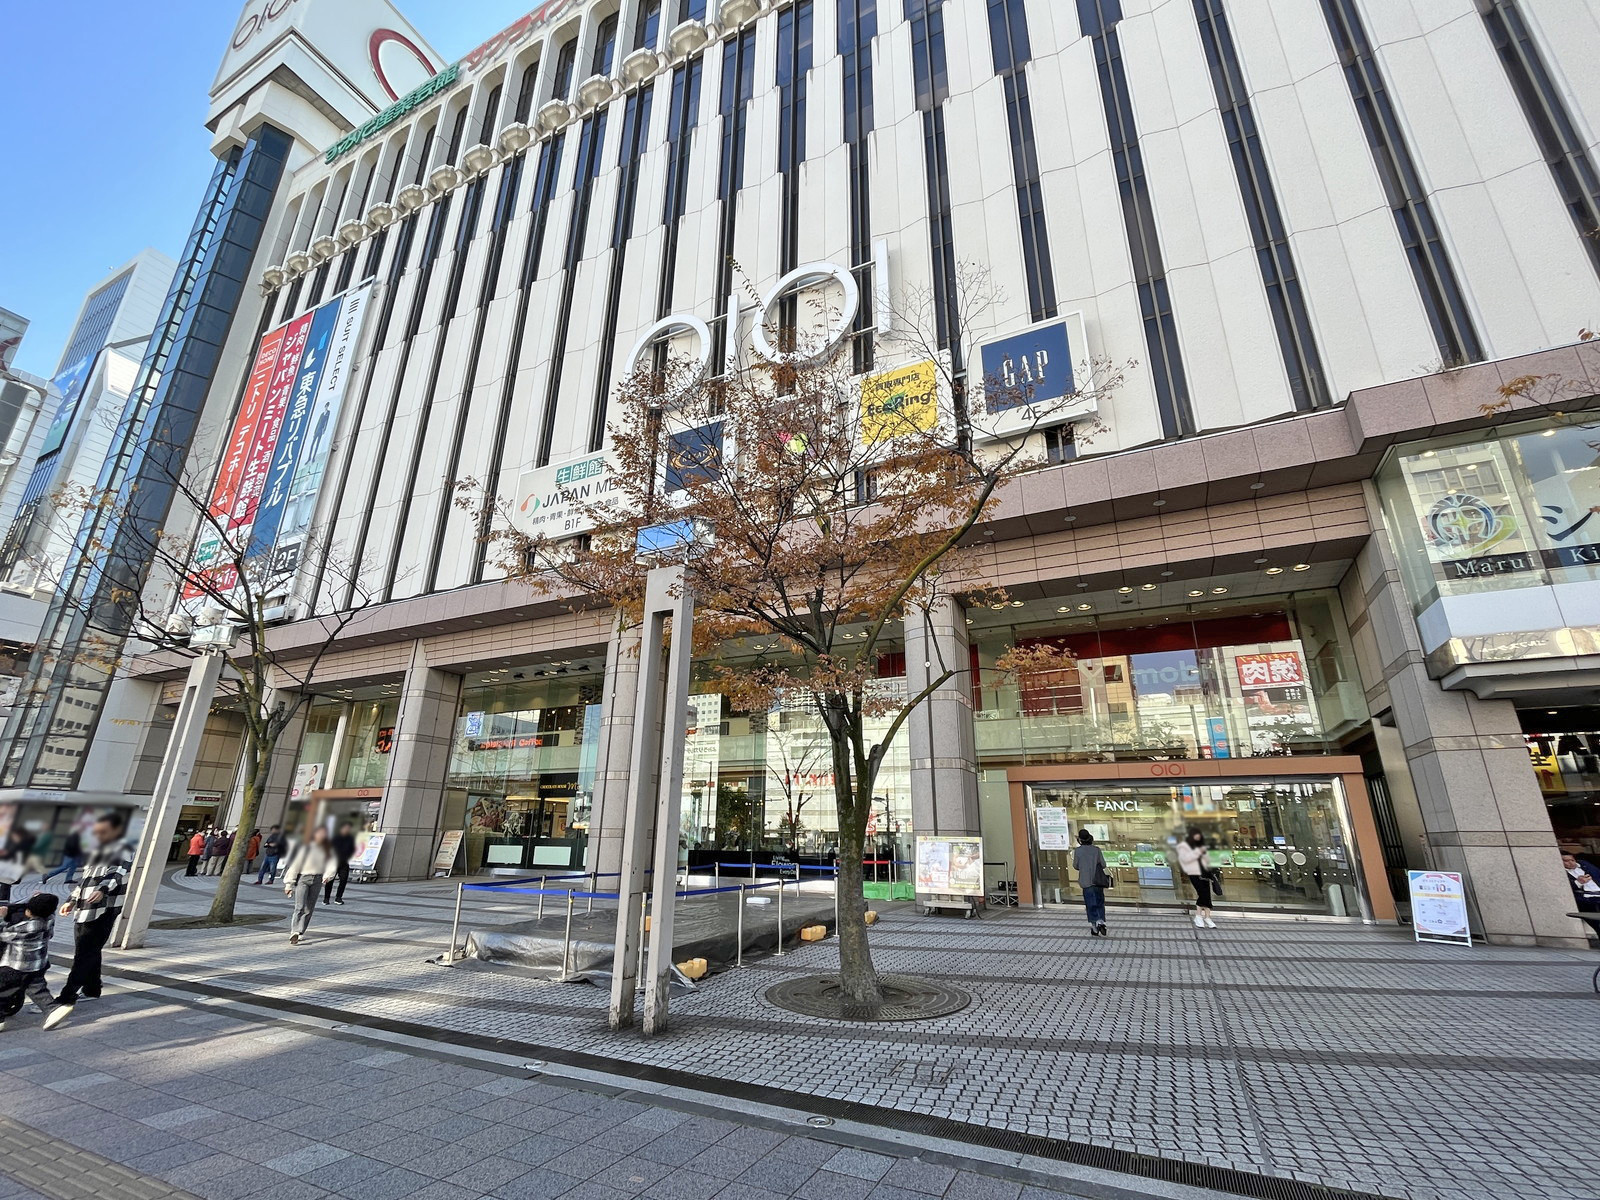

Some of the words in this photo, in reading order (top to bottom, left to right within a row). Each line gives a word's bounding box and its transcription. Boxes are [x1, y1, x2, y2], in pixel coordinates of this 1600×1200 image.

[342, 316, 355, 342] SUIT
[328, 345, 346, 391] SELECT
[1002, 350, 1049, 387] GAP
[246, 373, 266, 419] ニトリ
[235, 331, 300, 519] ジャパンミート生鮮館
[264, 371, 317, 509] 東急リバブル
[216, 423, 252, 507] デコホーム
[557, 457, 604, 483] 生鮮館
[542, 484, 590, 508] JAPAN
[595, 478, 620, 495] ME
[564, 517, 582, 531] B1F
[276, 548, 297, 570] 2F
[1455, 554, 1536, 577] Marui
[1096, 801, 1143, 812] FANCL
